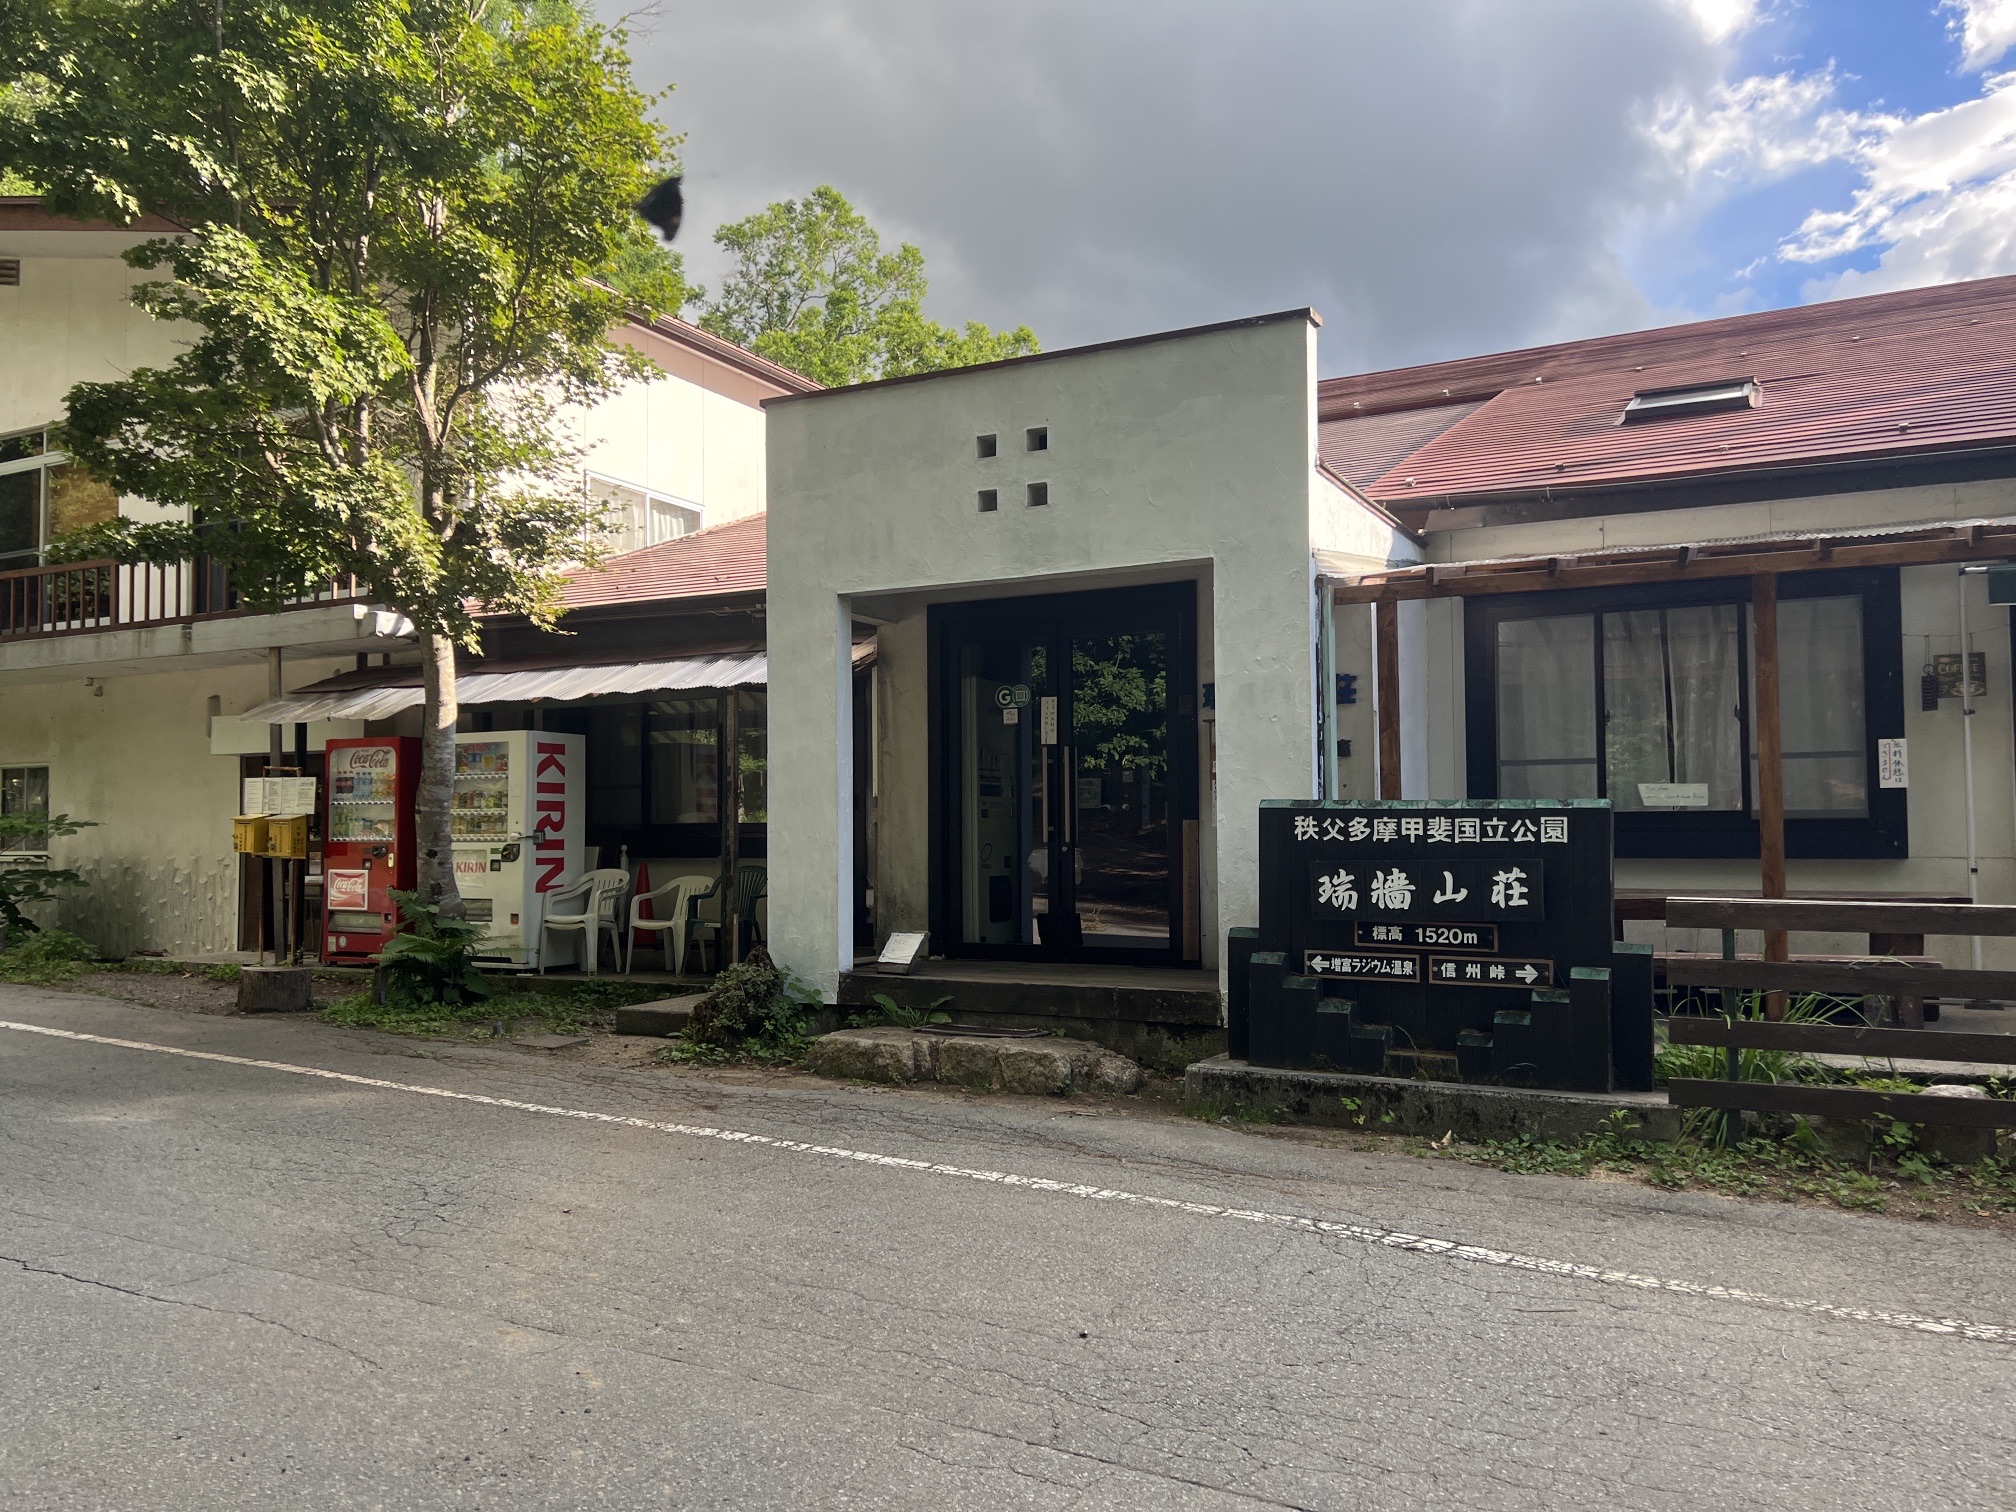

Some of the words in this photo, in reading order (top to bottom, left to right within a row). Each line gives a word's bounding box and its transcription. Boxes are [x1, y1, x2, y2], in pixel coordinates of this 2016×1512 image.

[350, 748, 391, 769] Coca-Cola
[535, 742, 565, 893] KIRIN
[1294, 815, 1568, 843] 秩父多摩甲斐国立公園
[455, 862, 487, 873] KIRIN
[333, 877, 364, 892] Coca-Cola
[1318, 866, 1529, 911] 瑞牆山荘
[1372, 925, 1403, 941] 標高
[1415, 927, 1478, 945] 1520m
[1331, 957, 1414, 976] 増富ラジウム温泉
[1440, 962, 1506, 981] 信州峠
